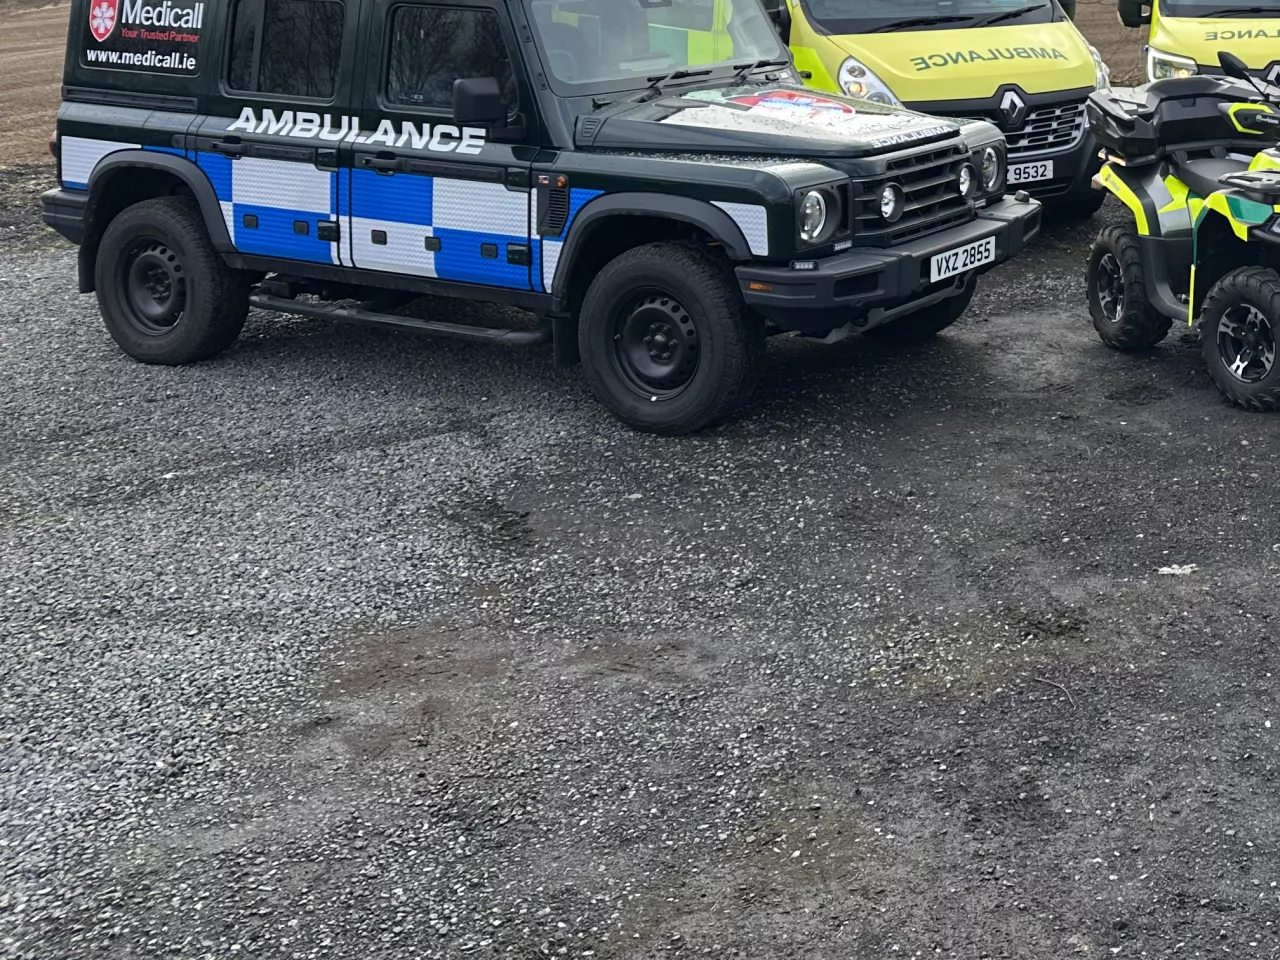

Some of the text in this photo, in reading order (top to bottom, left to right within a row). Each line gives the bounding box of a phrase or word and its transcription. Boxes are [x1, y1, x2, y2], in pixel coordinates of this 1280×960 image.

[121, 27, 200, 43] Your Trusted Partner
[86, 49, 196, 70] www.medicall.ie
[226, 106, 487, 155] AMBULANCE
[1013, 164, 1047, 181] 9532
[936, 240, 991, 277] VXZ 2855
